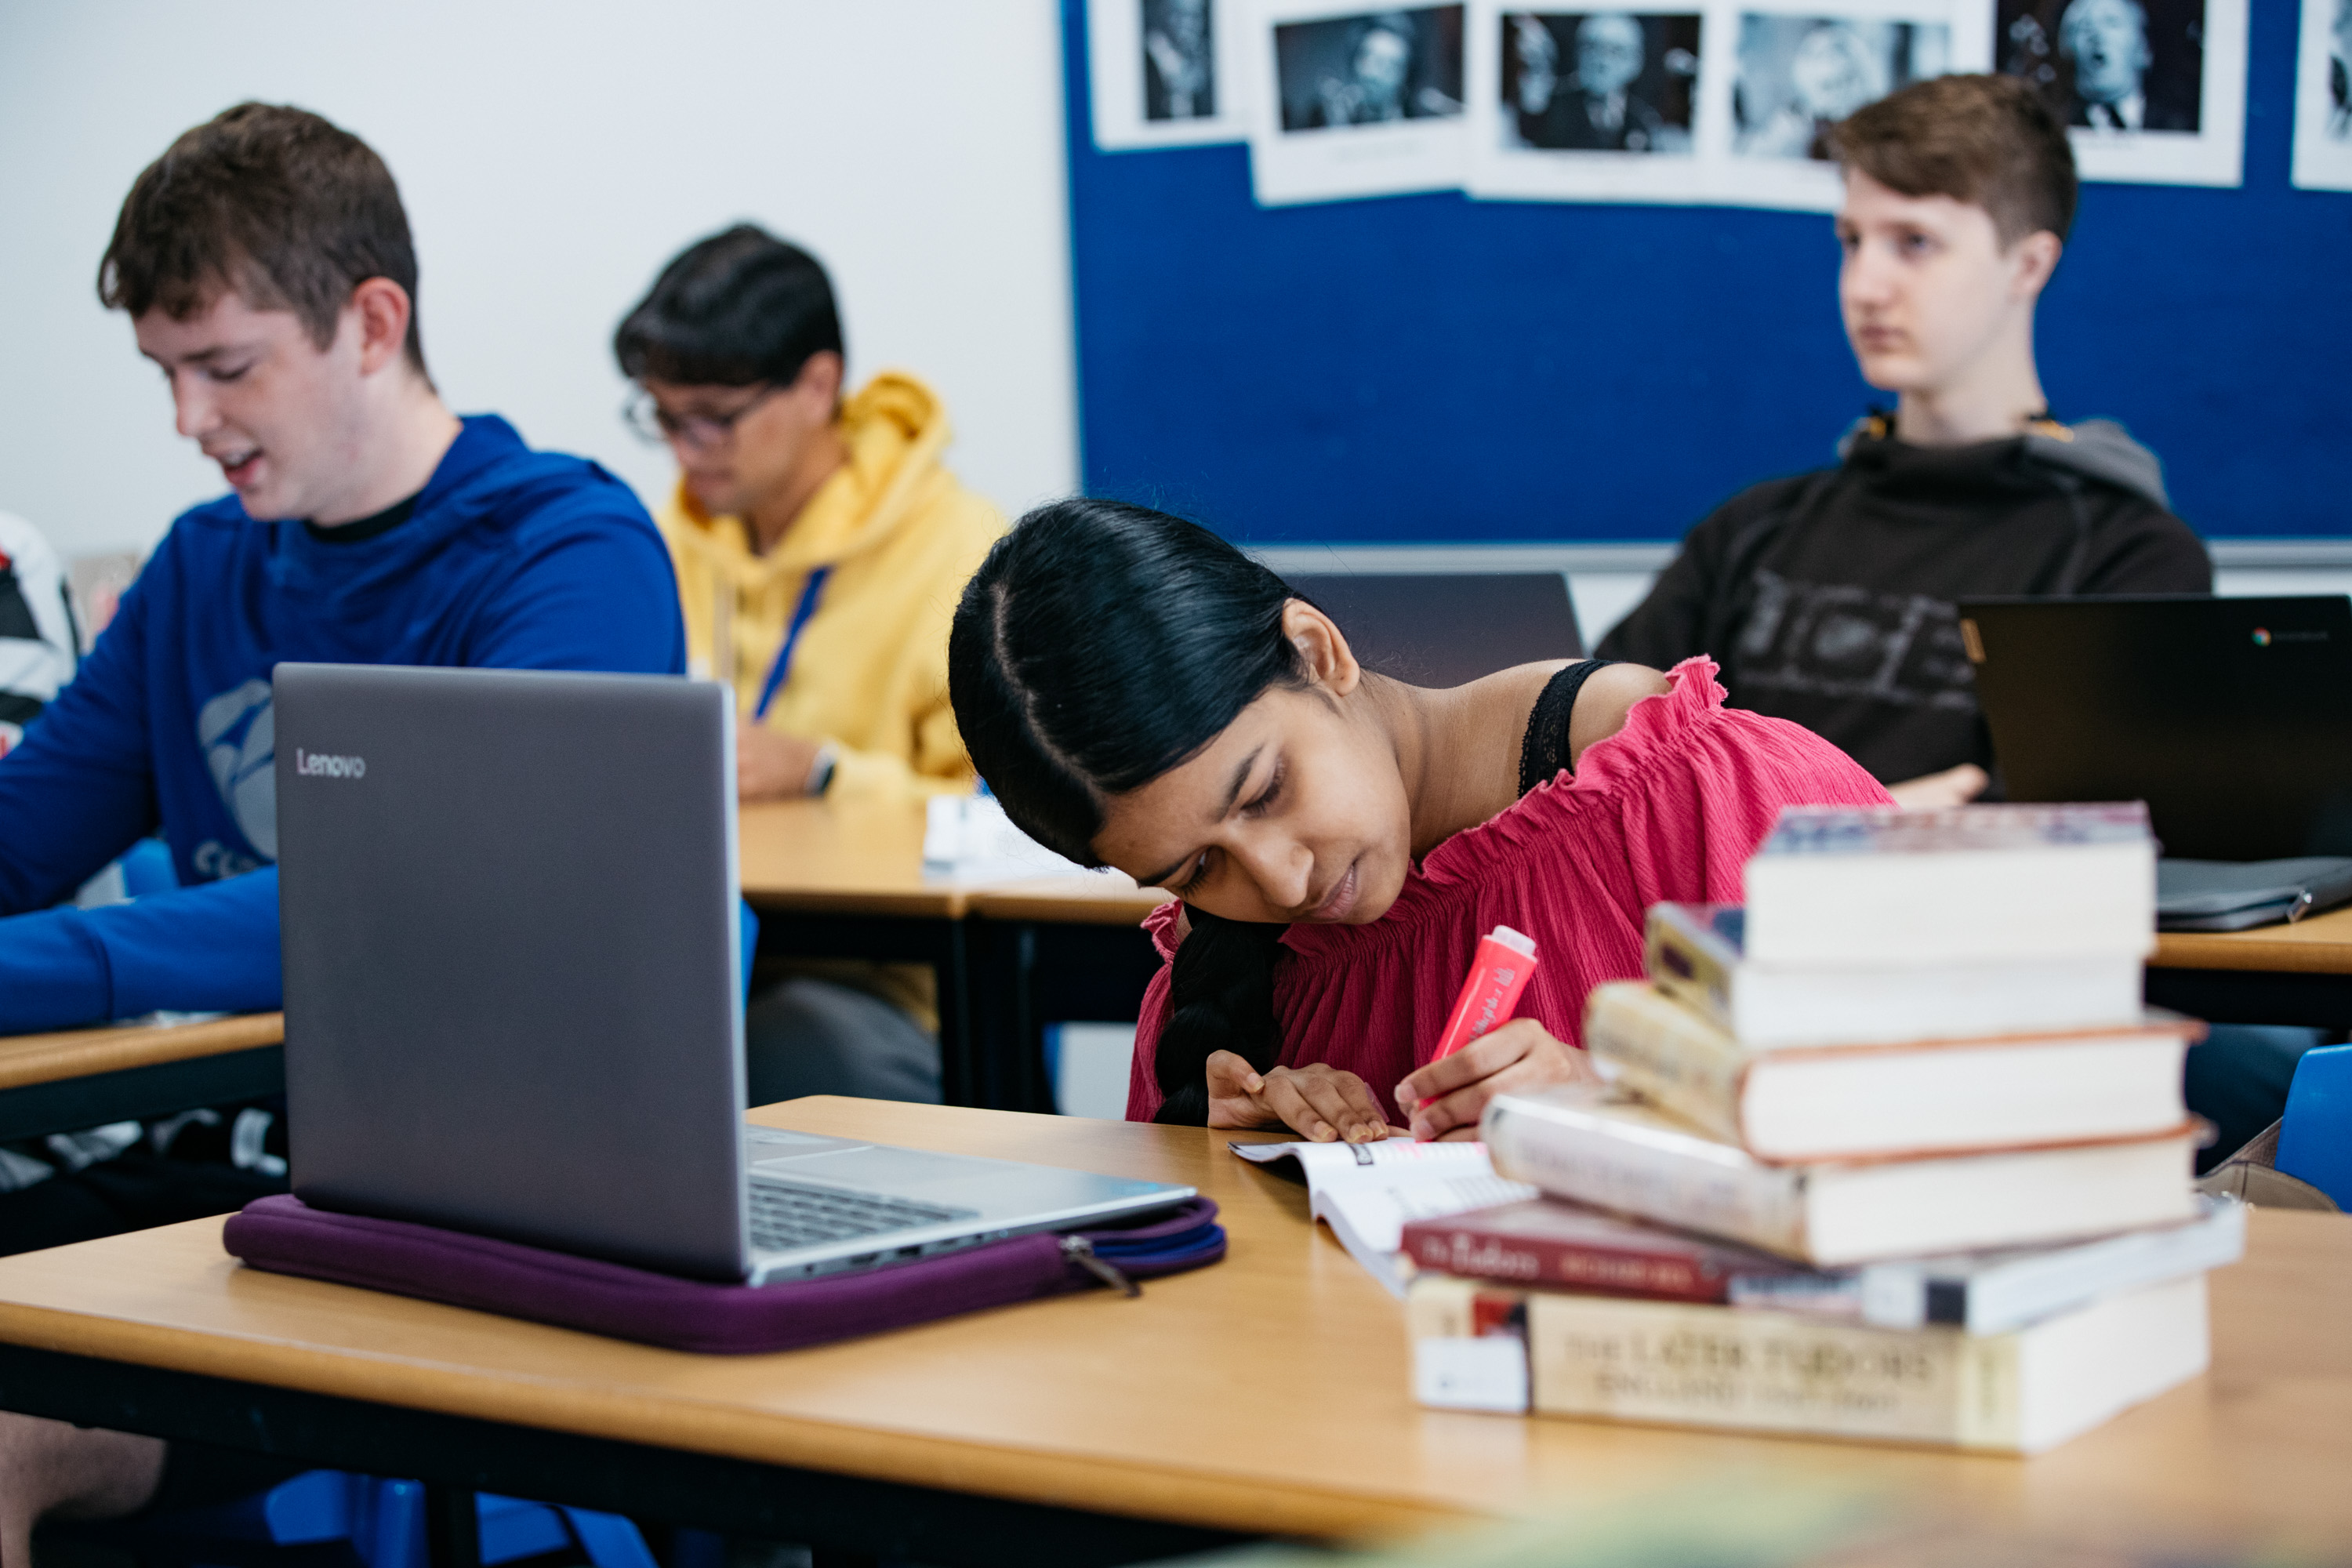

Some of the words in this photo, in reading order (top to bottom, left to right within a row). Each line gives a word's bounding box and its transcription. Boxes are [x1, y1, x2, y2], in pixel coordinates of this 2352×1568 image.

[296, 747, 366, 779] Lenovo
[1629, 1330, 1747, 1370] LATER
[1762, 1338, 1934, 1382] TUDORS
